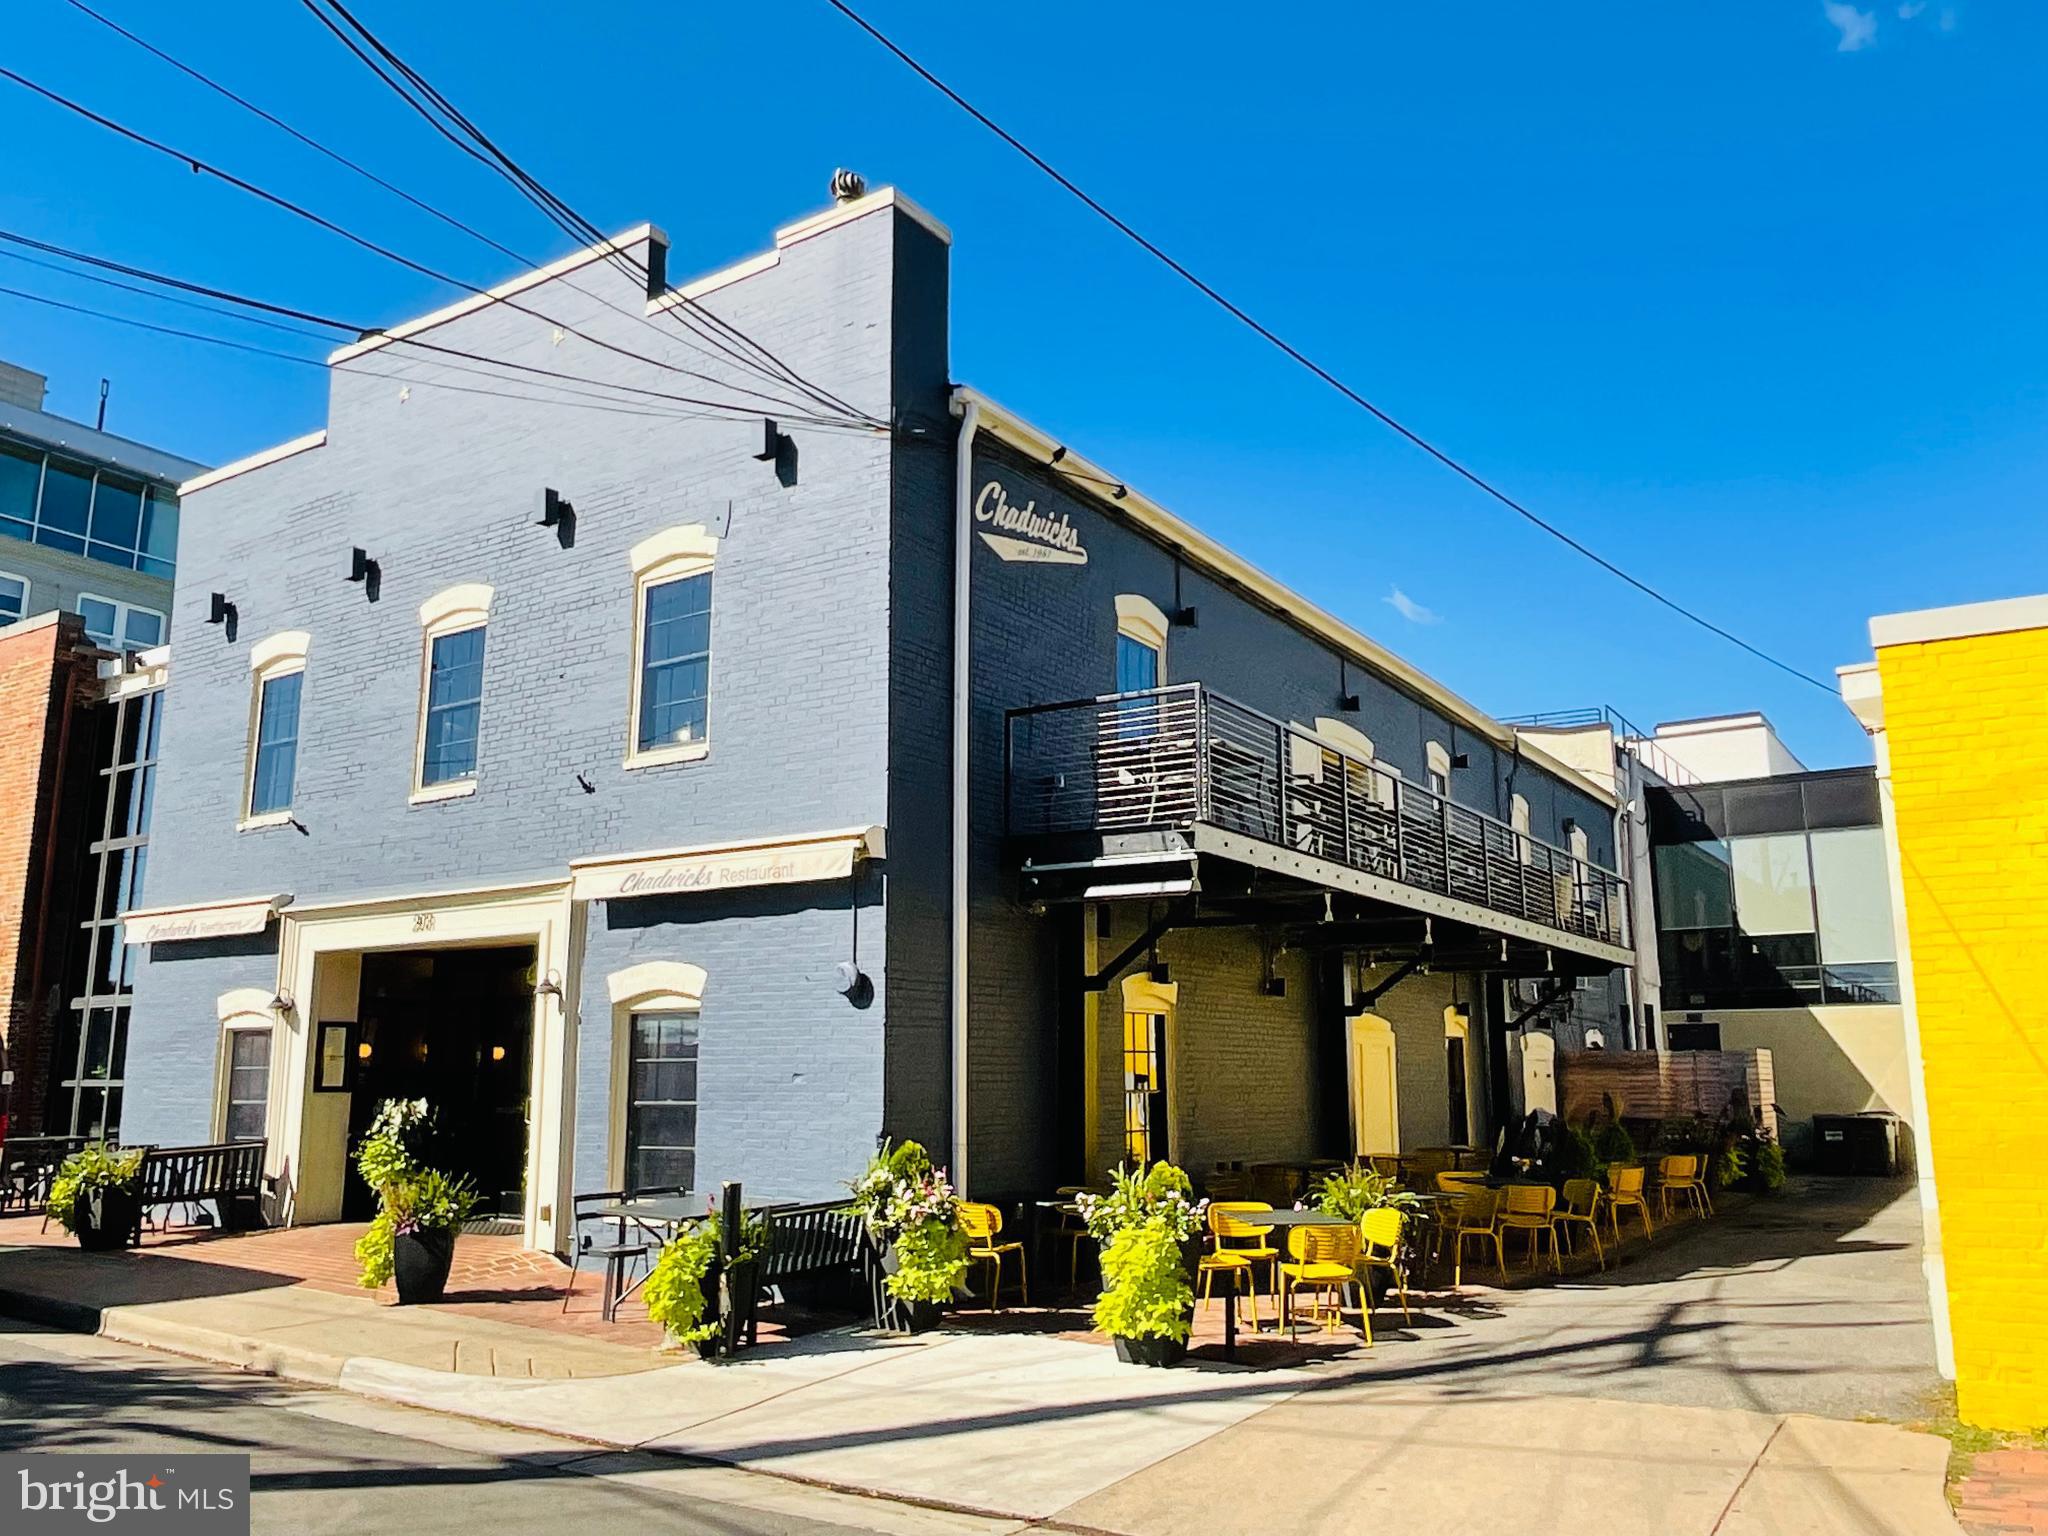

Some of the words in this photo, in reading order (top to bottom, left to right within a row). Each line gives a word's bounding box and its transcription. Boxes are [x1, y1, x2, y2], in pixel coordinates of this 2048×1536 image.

[975, 481, 1078, 551] Chadwicks
[620, 865, 713, 894] Chadwicks
[719, 862, 795, 884] Restaurant
